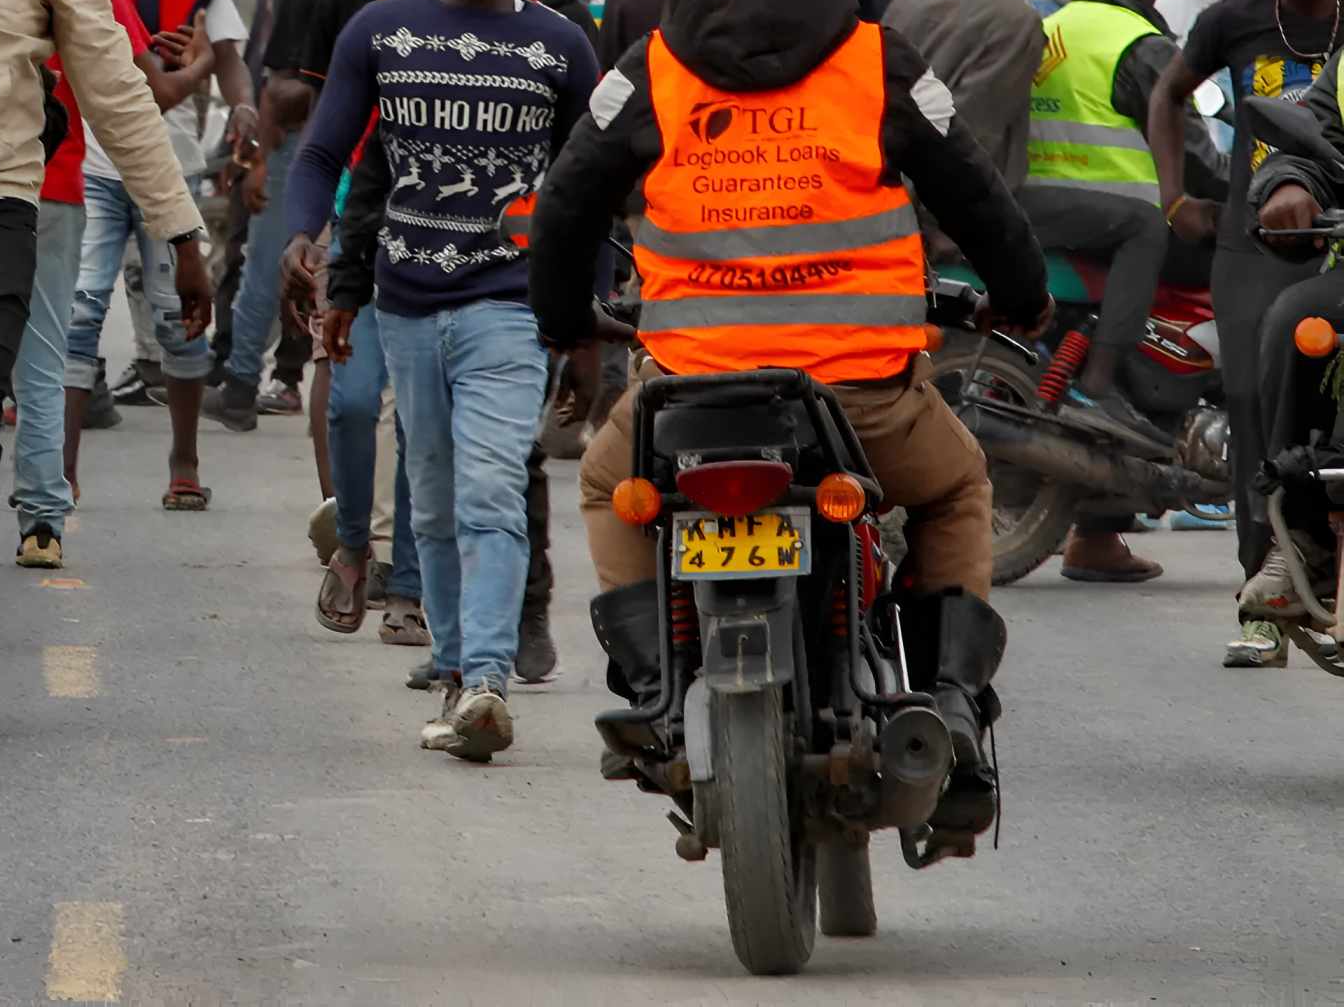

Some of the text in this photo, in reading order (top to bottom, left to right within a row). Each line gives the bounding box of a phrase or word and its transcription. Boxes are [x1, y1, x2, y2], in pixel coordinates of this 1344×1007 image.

[434, 98, 470, 131] HO
[476, 101, 513, 133] HO
[742, 106, 819, 135] TGL
[673, 143, 842, 170] Logbook Loans
[692, 172, 824, 194] Guarantees
[700, 202, 815, 223] Insurance
[688, 545, 795, 569] 476W
